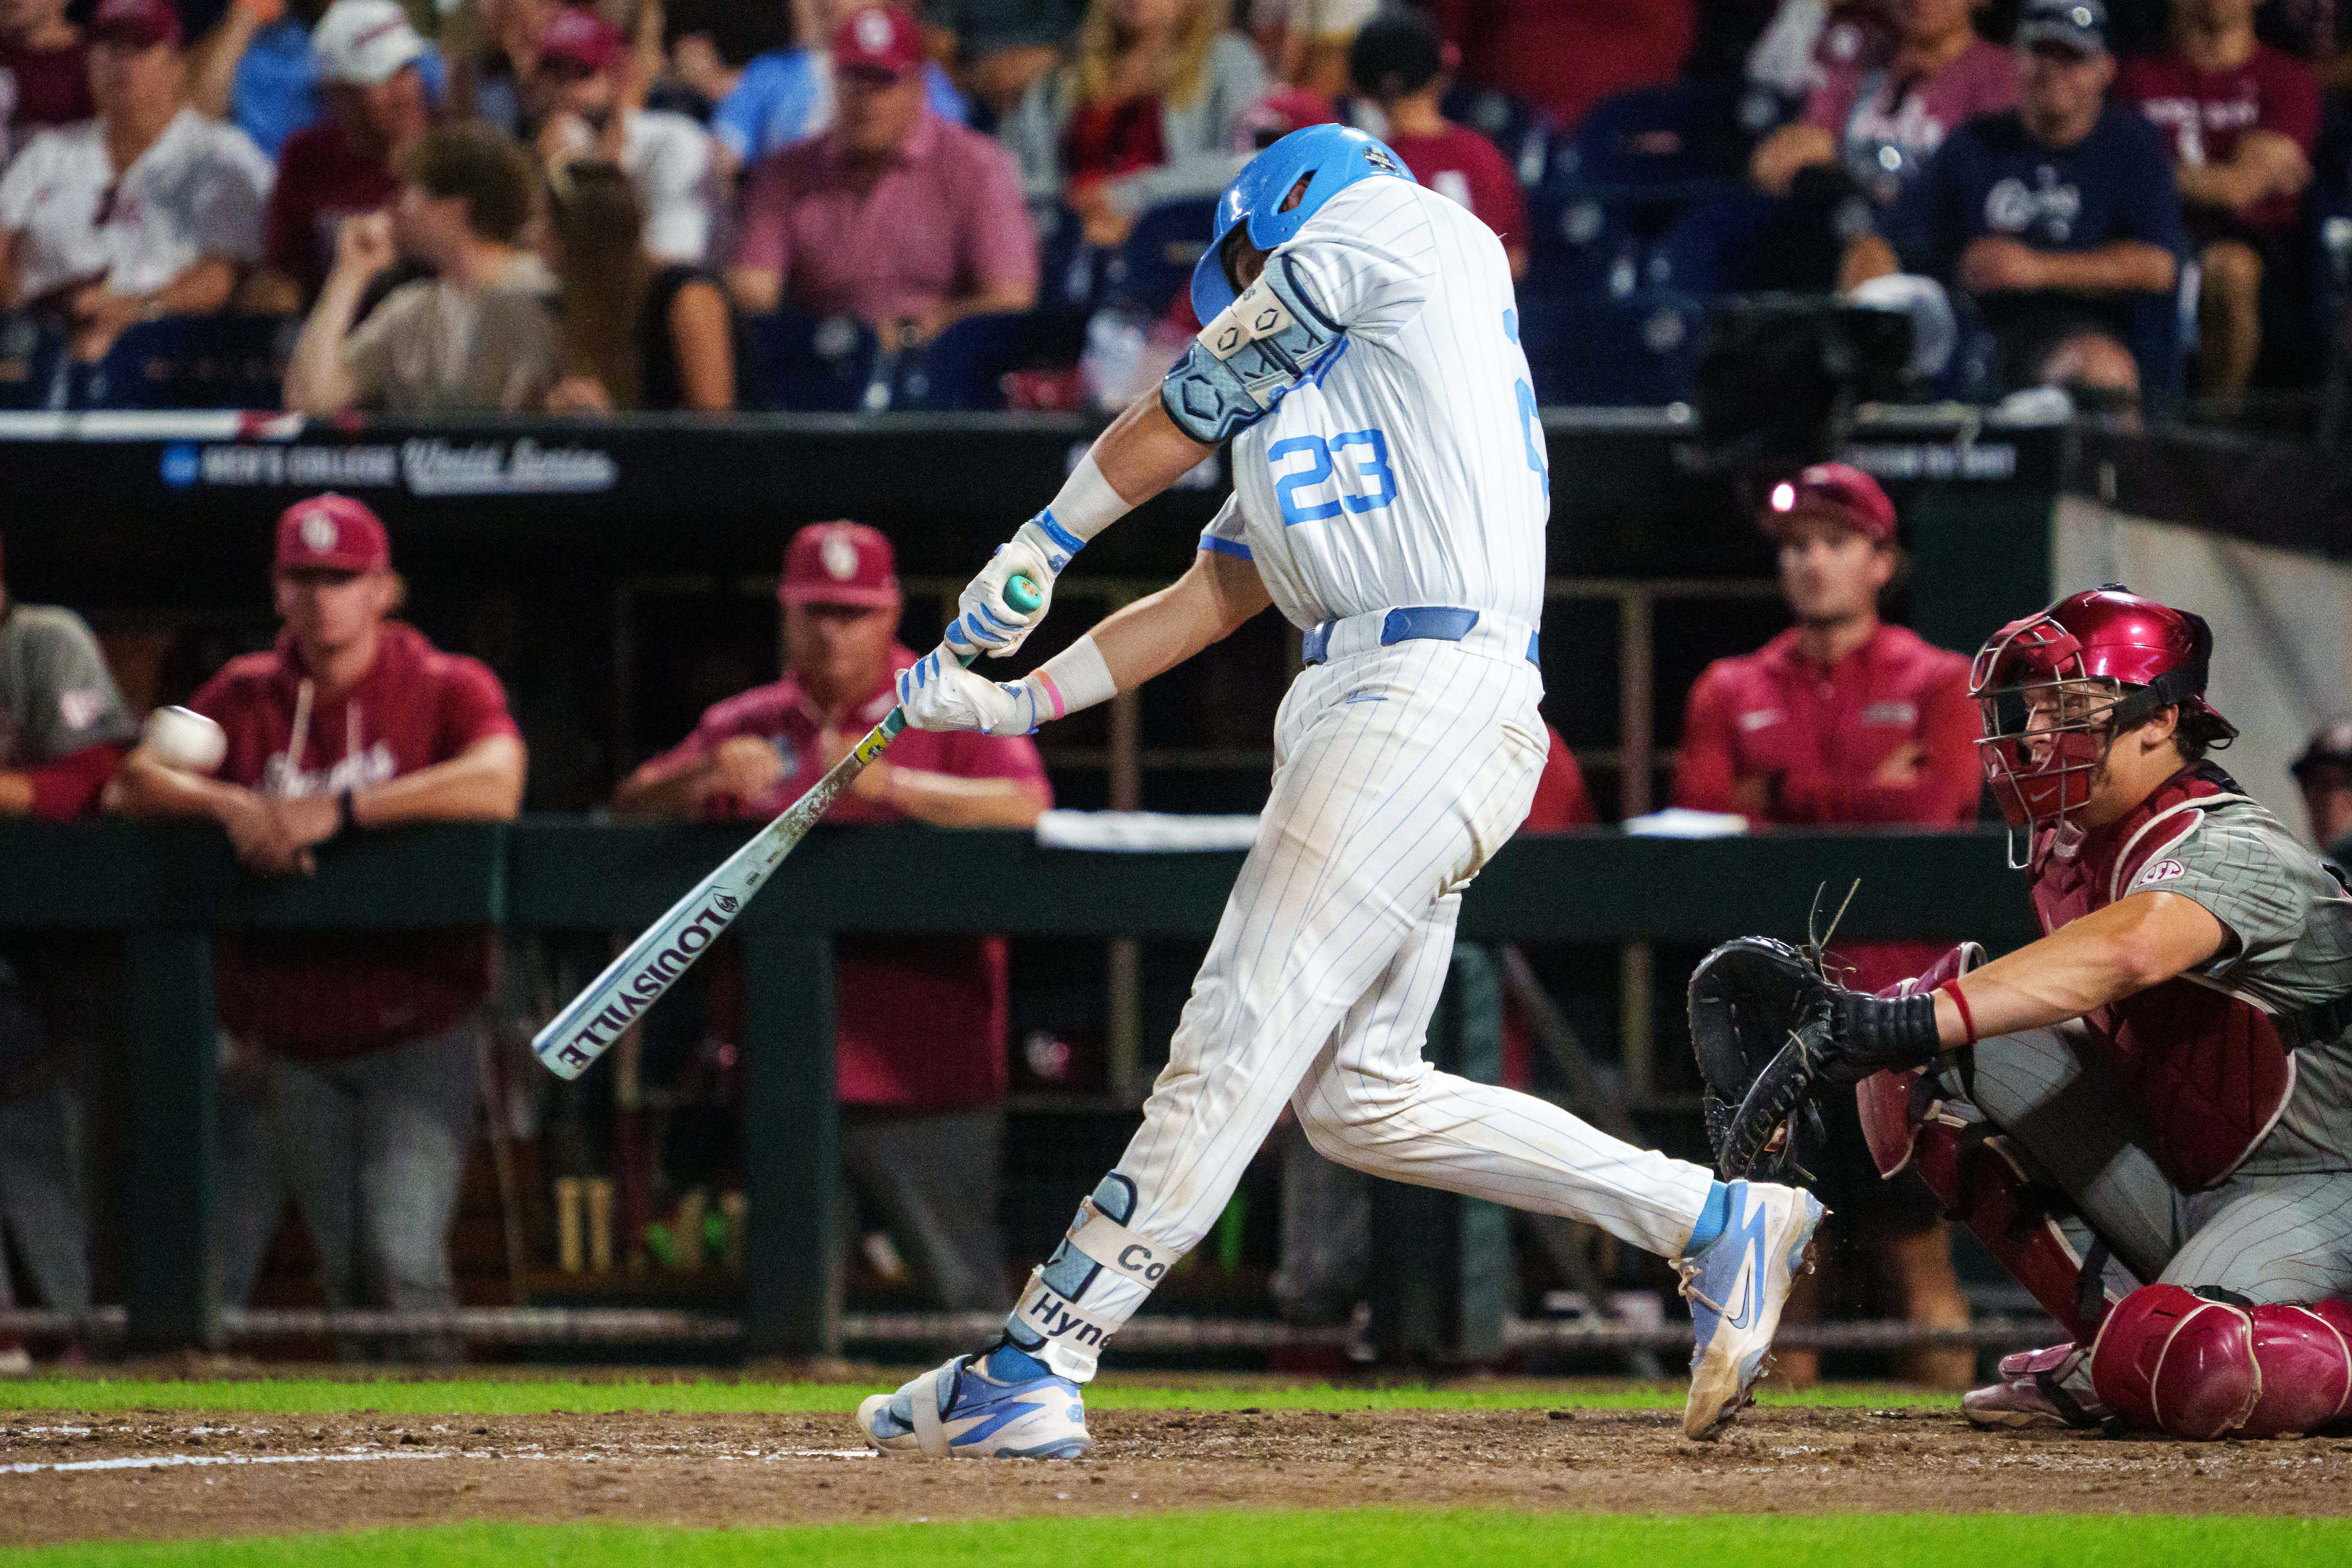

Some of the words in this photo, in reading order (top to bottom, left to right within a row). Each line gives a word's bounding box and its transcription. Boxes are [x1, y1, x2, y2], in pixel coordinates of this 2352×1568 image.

[1268, 428, 1397, 526] 23
[557, 908, 728, 1069] LOUISVILLE
[1118, 1244, 1165, 1281] Co
